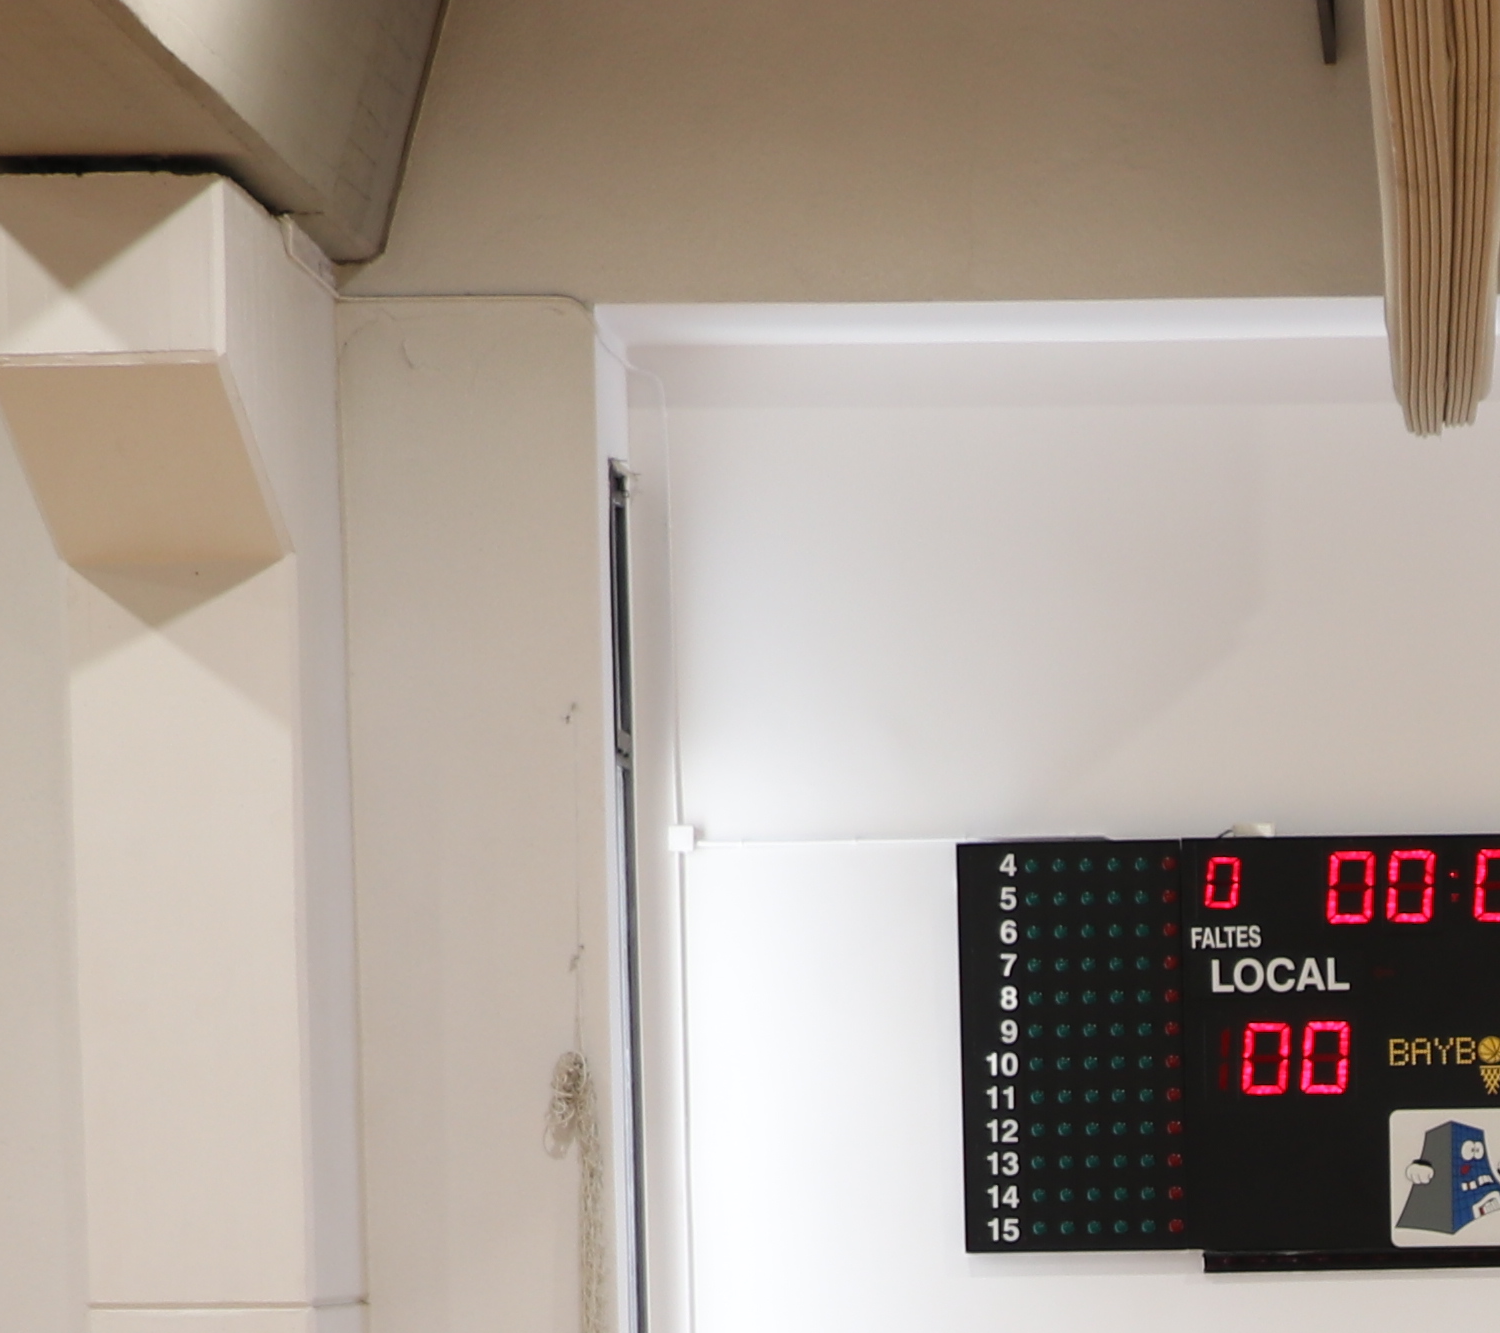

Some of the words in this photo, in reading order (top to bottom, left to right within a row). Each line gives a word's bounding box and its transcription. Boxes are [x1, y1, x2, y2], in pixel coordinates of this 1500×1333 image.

[999, 853, 1017, 877] 4
[1204, 856, 1241, 910] 0
[999, 886, 1017, 911] 5
[999, 919, 1018, 944] 6
[1190, 925, 1262, 949] FALTES
[999, 953, 1018, 977] 7
[1211, 957, 1350, 993] LOCAL
[1000, 985, 1018, 1011] 8
[1000, 1019, 1018, 1044] 9
[985, 1052, 1019, 1077] 10
[1241, 1020, 1351, 1096] 00
[986, 1085, 1016, 1110] 11
[986, 1118, 1019, 1143] 12
[986, 1151, 1020, 1176] 13
[987, 1184, 1020, 1209] 14
[987, 1217, 1020, 1242] 15
